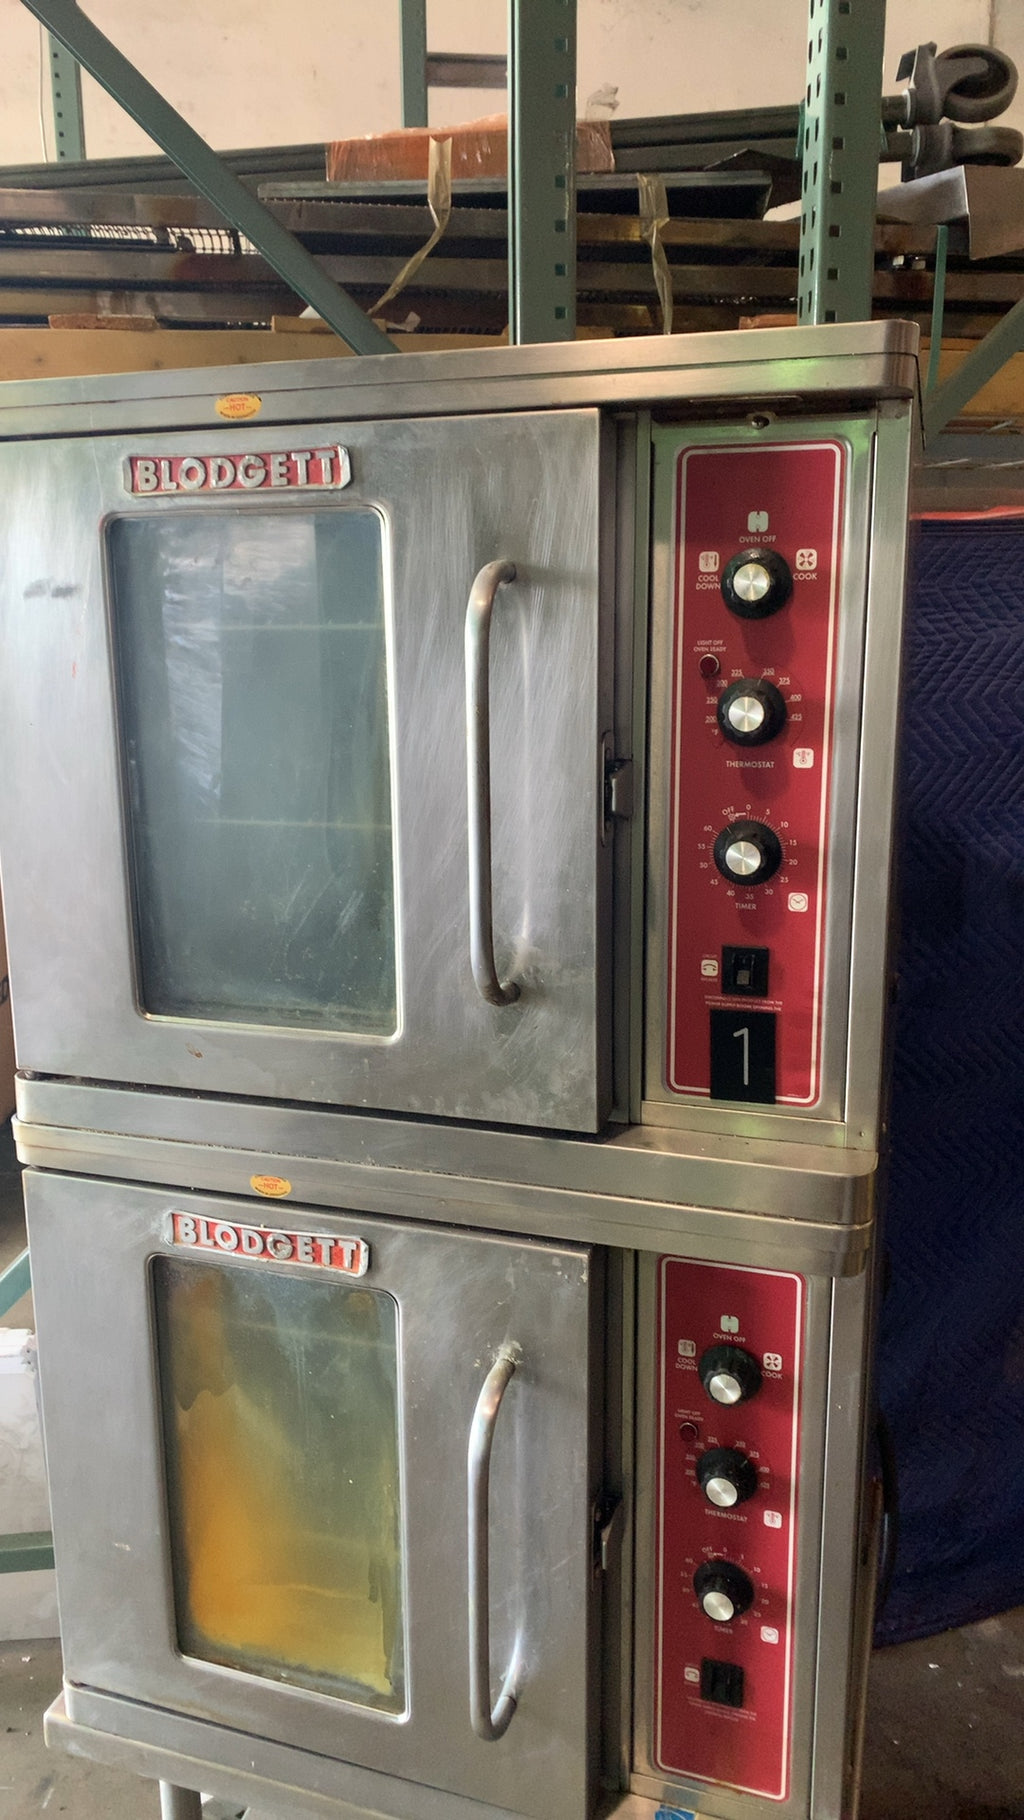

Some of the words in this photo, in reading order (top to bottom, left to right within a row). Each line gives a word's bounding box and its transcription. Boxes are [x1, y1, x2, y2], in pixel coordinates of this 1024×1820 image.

[229, 403, 246, 411] HOT
[136, 450, 337, 492] BLODGETT
[762, 535, 777, 543] OFF
[726, 760, 775, 768] THERMOSTAT
[733, 1027, 749, 1086] 1
[178, 1215, 358, 1270] BLODGETT
[713, 1333, 732, 1341] OVEN
[677, 1357, 696, 1365] COOL
[675, 1363, 698, 1371] DOWN
[761, 1370, 783, 1379] COOK
[705, 1509, 748, 1522] THERMOSTAT
